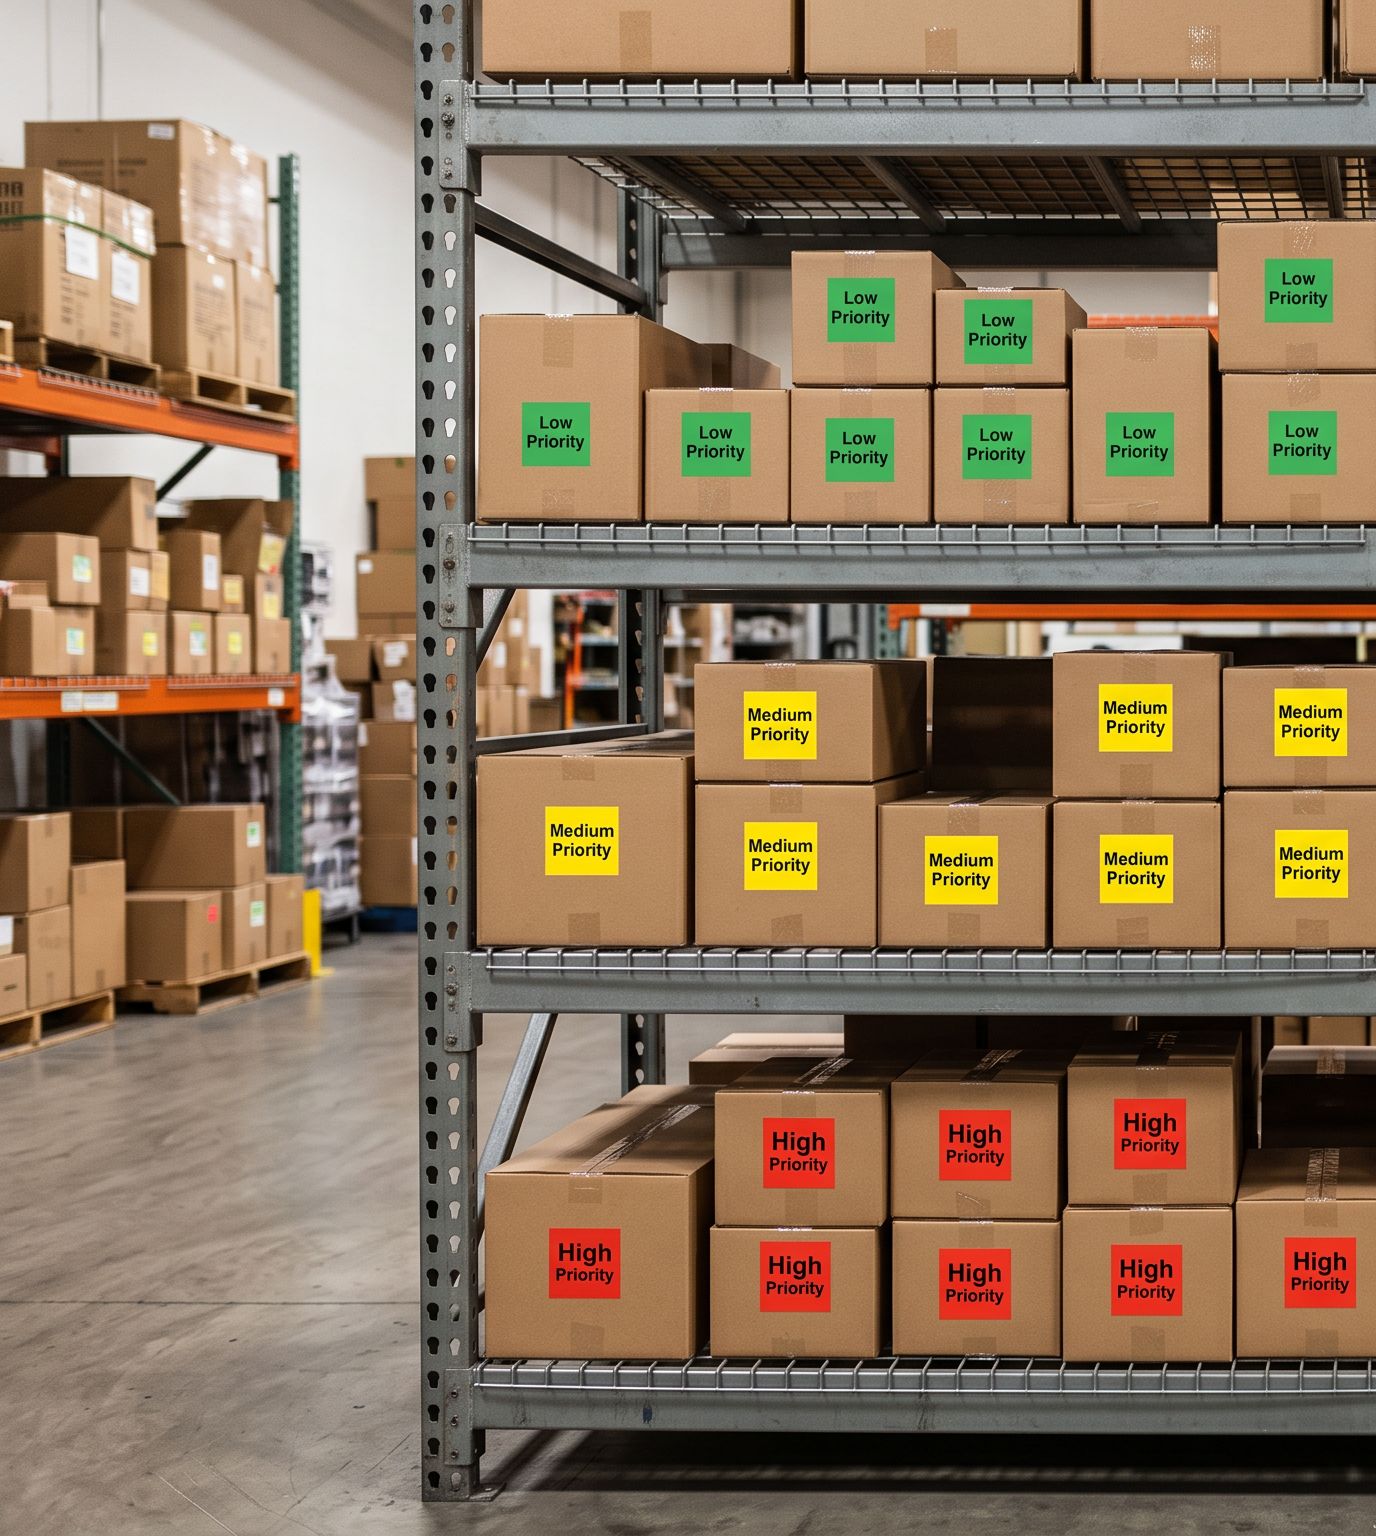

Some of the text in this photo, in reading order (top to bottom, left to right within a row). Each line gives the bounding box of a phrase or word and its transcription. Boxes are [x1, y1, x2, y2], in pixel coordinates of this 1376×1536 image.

[1282, 271, 1316, 286] Low
[844, 290, 878, 305] Low
[1269, 290, 1328, 309] Priority
[831, 309, 890, 328] Priority
[981, 313, 1016, 328] Low
[968, 332, 1028, 350] Priority
[539, 415, 573, 430] Low
[1285, 424, 1319, 438] Low
[699, 425, 733, 440] Low
[842, 431, 877, 446] Low
[979, 427, 1014, 442] Low
[1122, 425, 1157, 440] Low
[526, 434, 585, 452] Priority
[1273, 442, 1332, 461] Priority
[686, 444, 745, 462] Priority
[830, 450, 889, 468] Priority
[967, 446, 1026, 465] Priority
[1110, 444, 1169, 462] Priority
[748, 707, 812, 722] Medium
[1103, 700, 1168, 715] Medium
[1278, 704, 1343, 719] Medium
[750, 726, 810, 745] Priority
[1106, 719, 1166, 738] Priority
[1281, 723, 1341, 742] Priority
[550, 823, 614, 838] Medium
[552, 842, 612, 861] Priority
[748, 838, 813, 853] Medium
[1279, 846, 1344, 861] Medium
[751, 857, 811, 876] Priority
[929, 852, 994, 868] Medium
[1104, 851, 1169, 866] Medium
[932, 871, 991, 891] Priority
[1107, 870, 1166, 889] Priority
[1282, 865, 1341, 884] Priority
[1124, 1112, 1177, 1138] High
[772, 1131, 826, 1157] High
[948, 1123, 1002, 1149] High
[1121, 1138, 1180, 1156] Priority
[769, 1157, 828, 1175] Priority
[946, 1149, 1005, 1168] Priority
[558, 1242, 612, 1267] High
[768, 1255, 822, 1281] High
[1120, 1258, 1173, 1284] High
[1293, 1251, 1347, 1277] High
[555, 1267, 615, 1285] Priority
[948, 1262, 1002, 1288] High
[766, 1280, 825, 1299] Priority
[1117, 1284, 1176, 1302] Priority
[1291, 1276, 1350, 1295] Priority
[945, 1288, 1004, 1306] Priority
